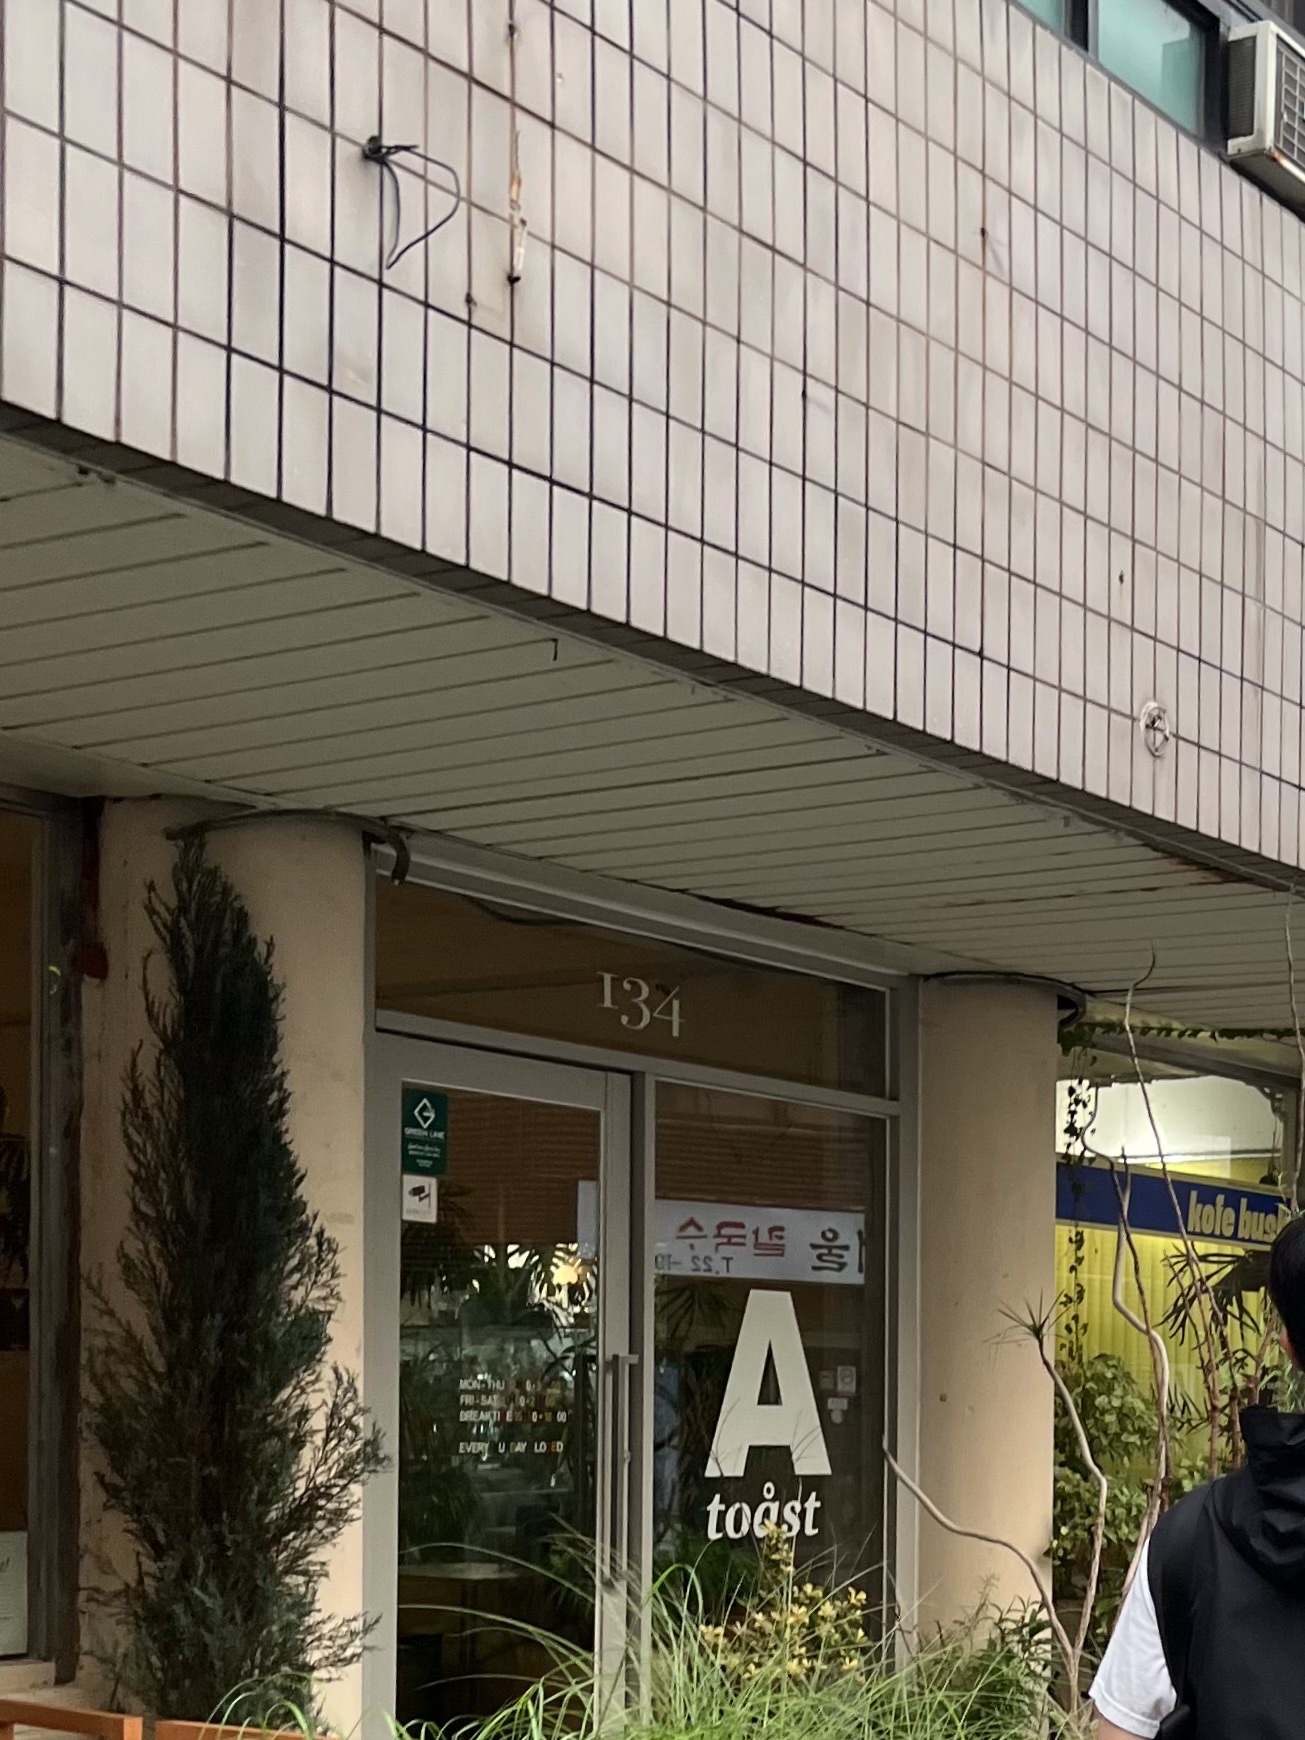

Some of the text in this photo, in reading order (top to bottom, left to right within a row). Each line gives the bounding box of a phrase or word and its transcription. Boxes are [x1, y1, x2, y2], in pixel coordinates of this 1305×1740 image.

[596, 971, 686, 1038] 134
[1187, 1190, 1236, 1238] kofe
[704, 1289, 832, 1477] A
